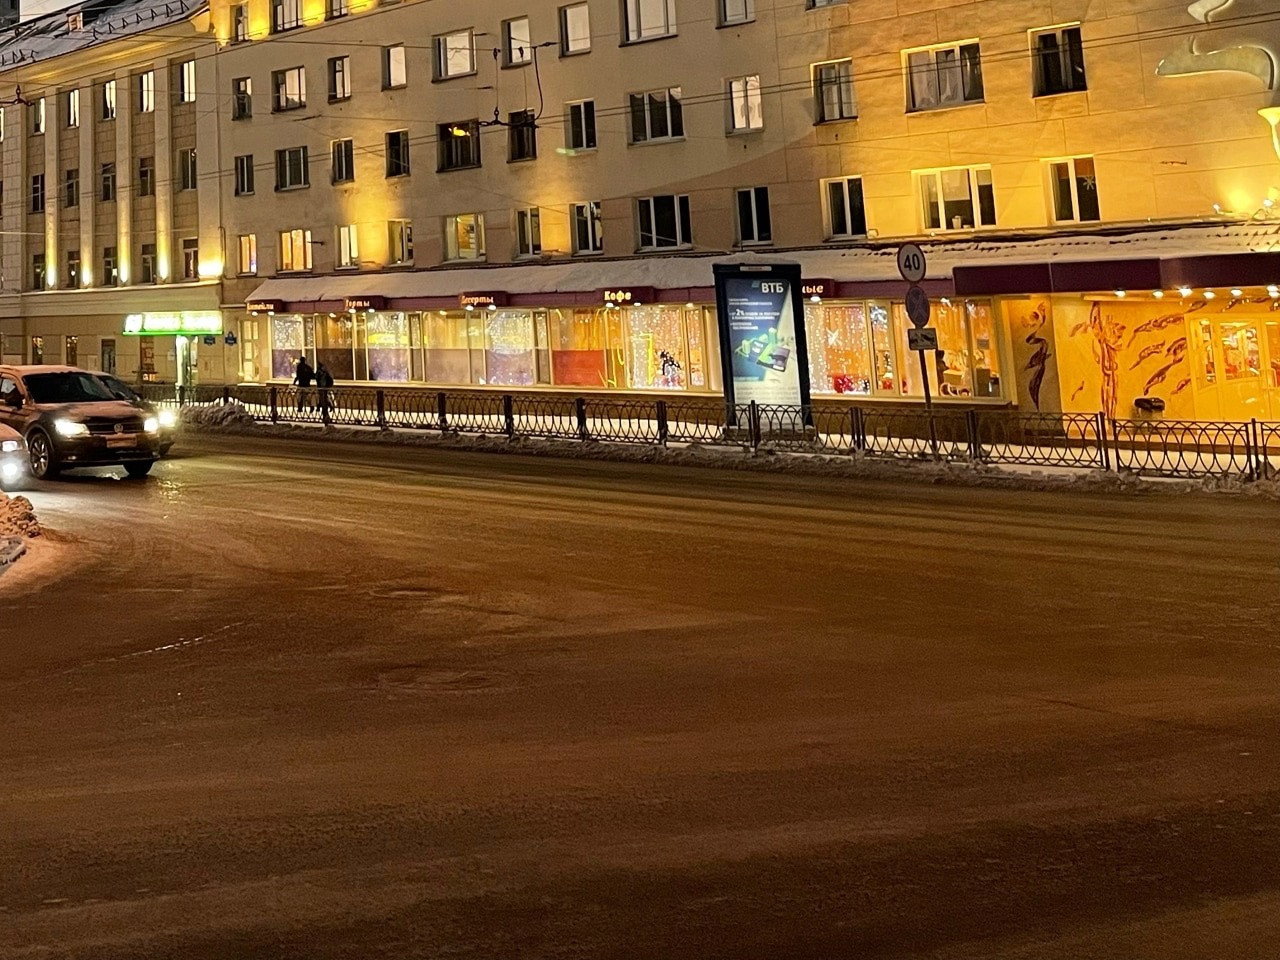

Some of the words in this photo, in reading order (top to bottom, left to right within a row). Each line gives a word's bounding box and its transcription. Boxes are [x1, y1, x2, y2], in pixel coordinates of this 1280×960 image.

[904, 253, 920, 271] 40
[761, 282, 784, 293] ВТБ
[604, 290, 632, 302] Кофе
